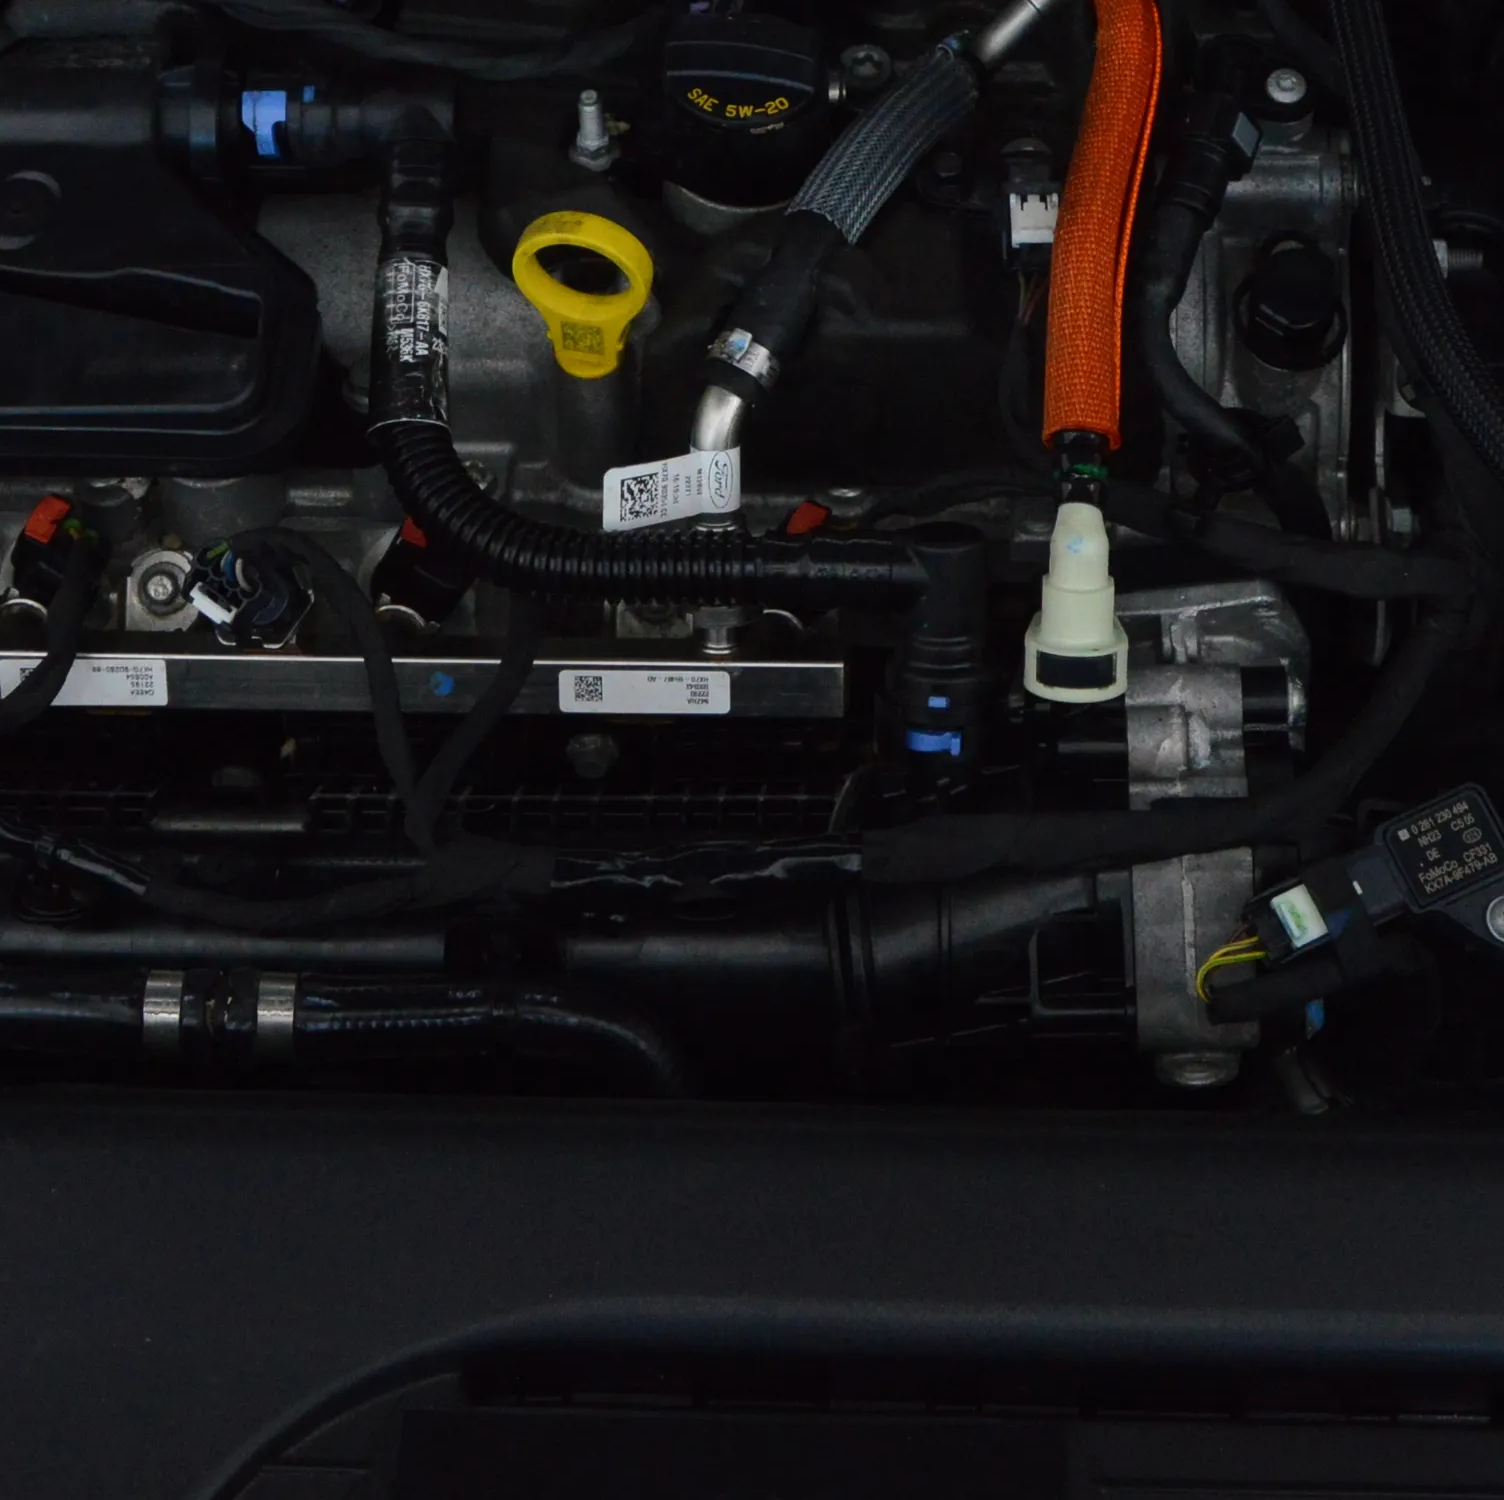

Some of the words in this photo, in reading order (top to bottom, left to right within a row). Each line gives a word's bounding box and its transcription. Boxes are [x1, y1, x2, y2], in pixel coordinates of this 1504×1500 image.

[686, 87, 719, 112] SAE
[724, 96, 791, 119] 5W-20
[395, 265, 409, 321] FoMoCo
[712, 460, 729, 498] Ford
[1410, 823, 1419, 834] 0
[1434, 807, 1453, 823] 230
[1451, 800, 1469, 815] 494
[1418, 859, 1458, 883] FoMoCo
[1463, 843, 1493, 863] CF331
[1424, 853, 1498, 894] KX7A-9F479-AB
